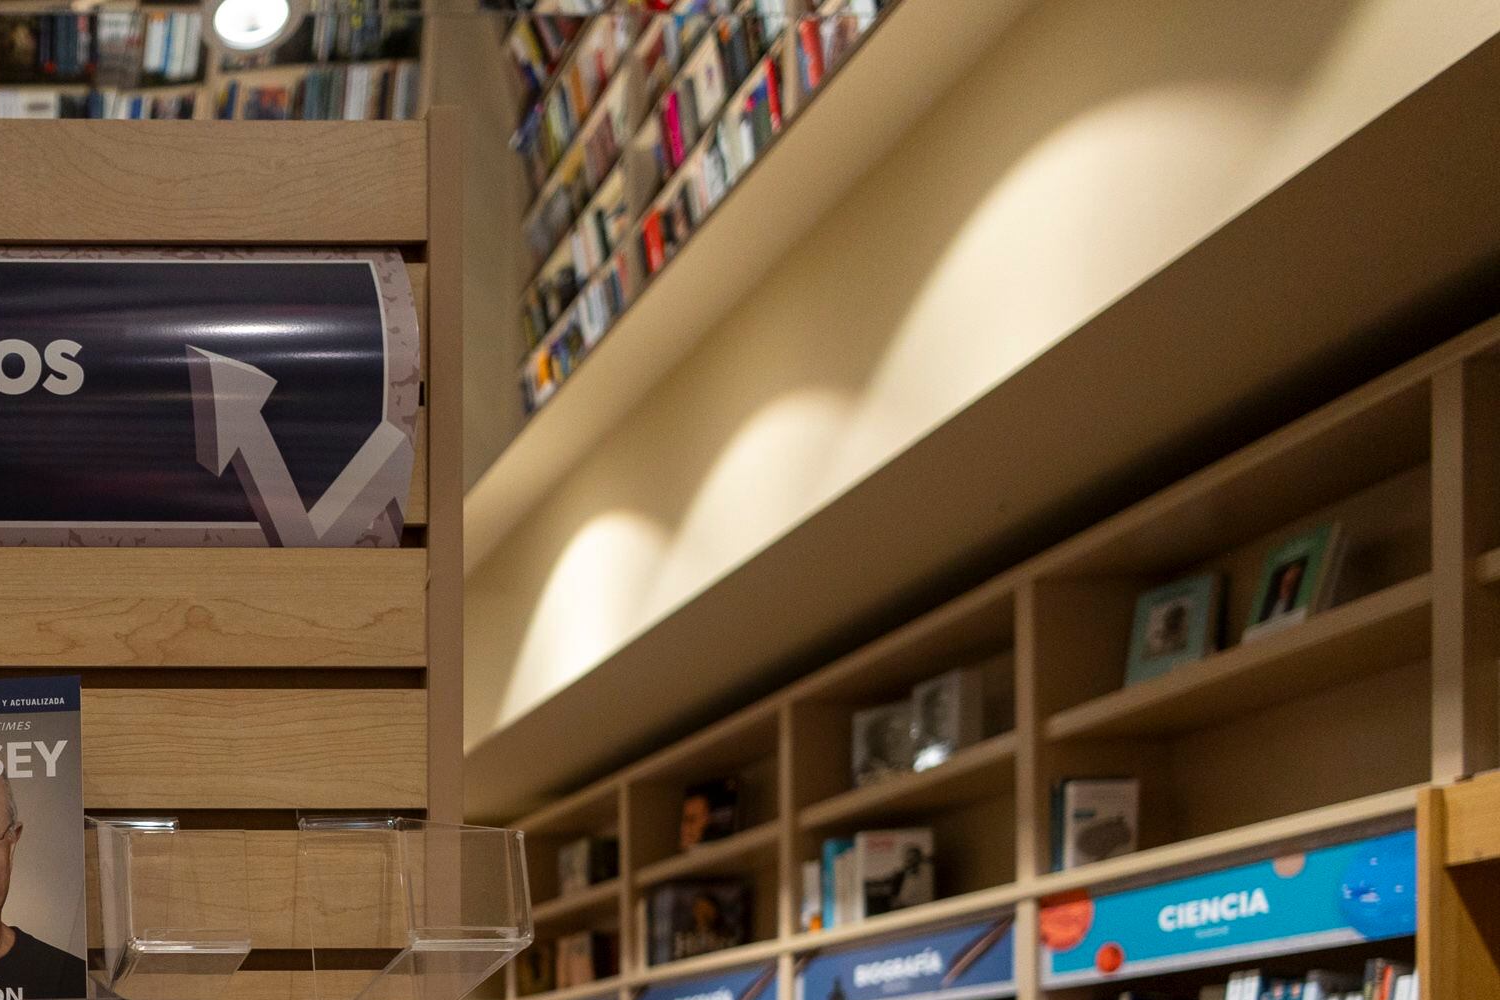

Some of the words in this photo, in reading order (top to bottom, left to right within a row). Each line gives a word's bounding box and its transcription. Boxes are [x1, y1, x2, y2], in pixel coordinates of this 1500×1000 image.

[2, 699, 7, 707] Y
[10, 697, 65, 707] ACTUALIZADA
[1158, 887, 1269, 932] CIENCIA
